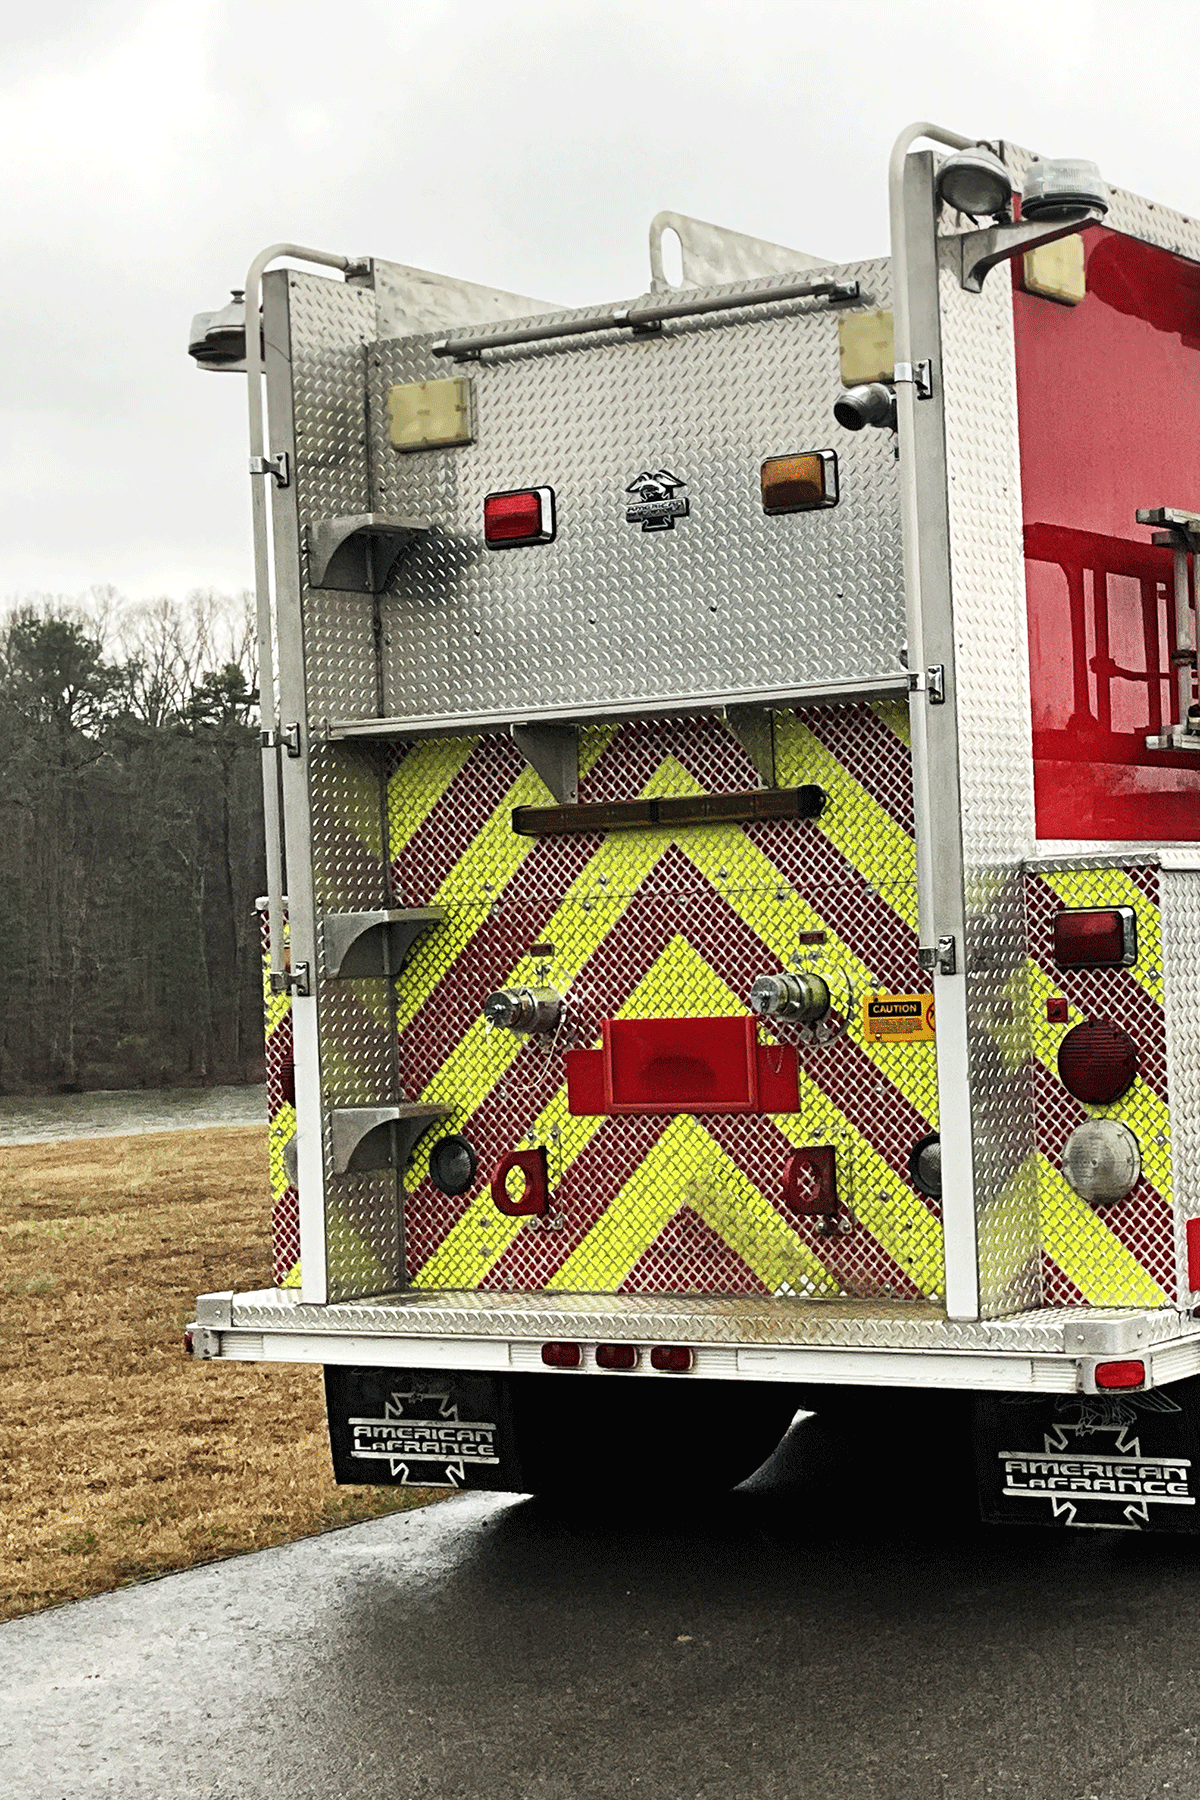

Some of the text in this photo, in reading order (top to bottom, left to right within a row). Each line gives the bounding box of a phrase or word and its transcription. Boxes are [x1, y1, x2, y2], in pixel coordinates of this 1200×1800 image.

[872, 1004, 917, 1014] CAUTION
[353, 1426, 493, 1443] AMERICAN
[1005, 1461, 1188, 1480] AMERICAN
